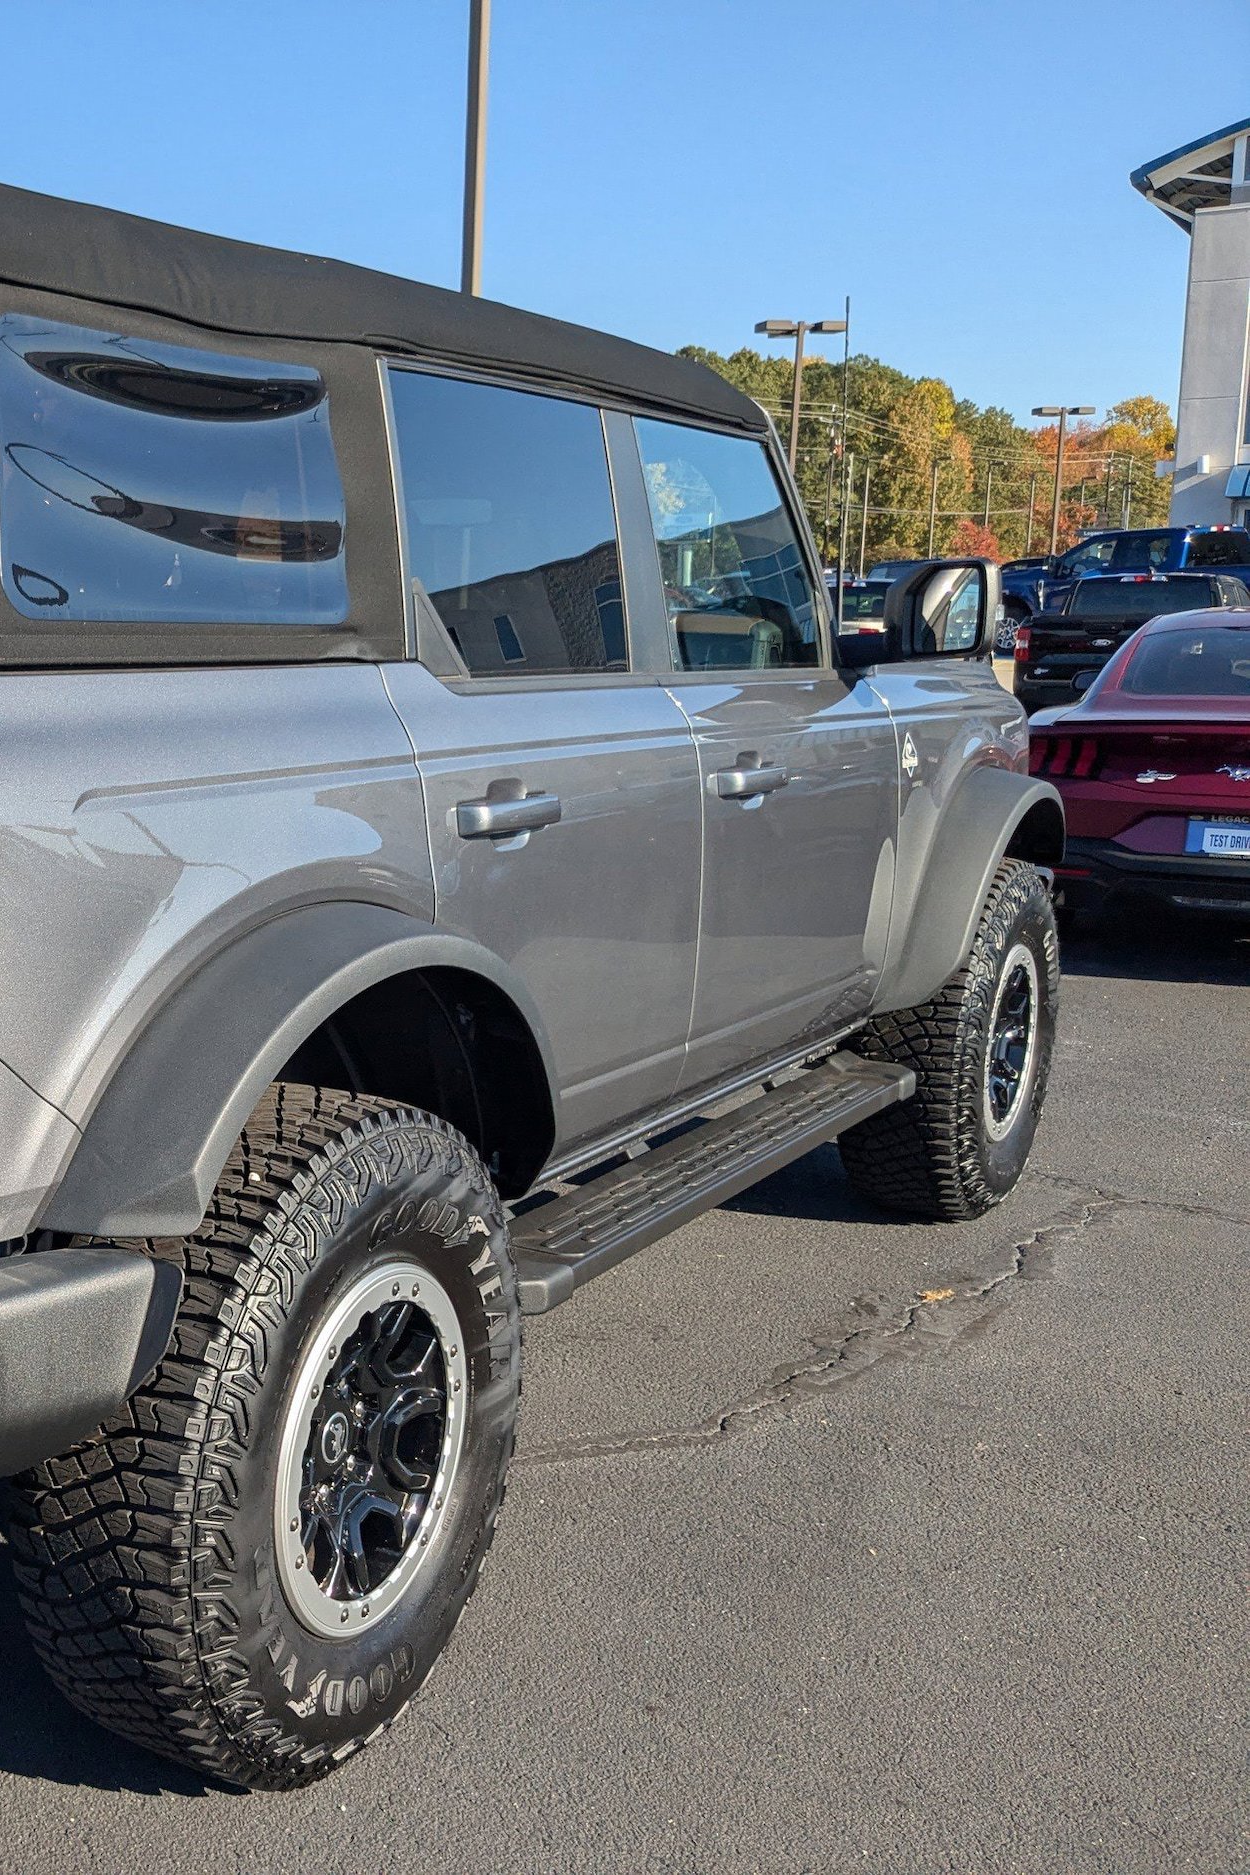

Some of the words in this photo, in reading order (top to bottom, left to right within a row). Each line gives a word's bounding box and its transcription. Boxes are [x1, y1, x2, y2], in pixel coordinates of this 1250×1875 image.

[1210, 834, 1229, 848] TEST
[1230, 835, 1250, 849] DRIV
[368, 1197, 512, 1381] GOODYEAR
